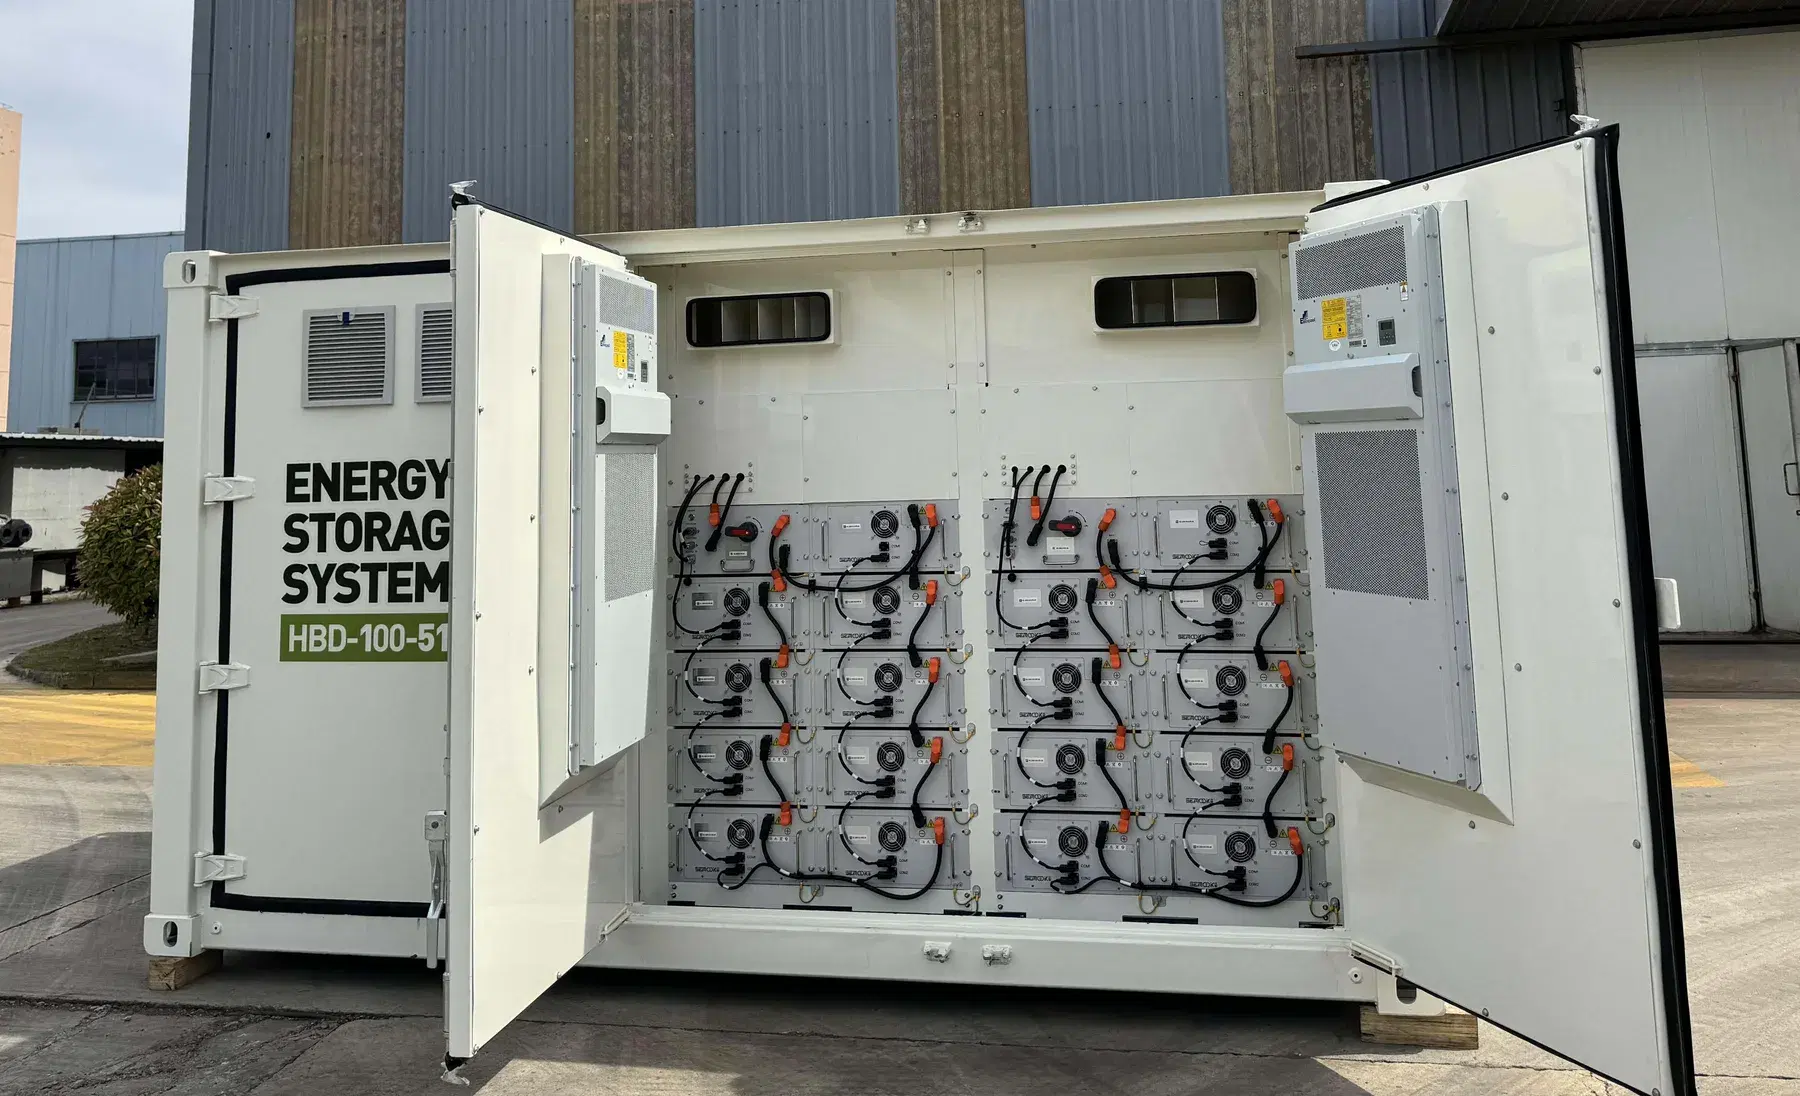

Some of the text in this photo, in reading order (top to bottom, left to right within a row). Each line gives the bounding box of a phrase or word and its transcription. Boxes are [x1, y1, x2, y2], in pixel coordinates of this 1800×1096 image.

[286, 459, 450, 502] ENERGY
[282, 510, 450, 554] STORAG
[281, 561, 450, 604] SYSTEM
[288, 623, 448, 652] HBD-100-51
